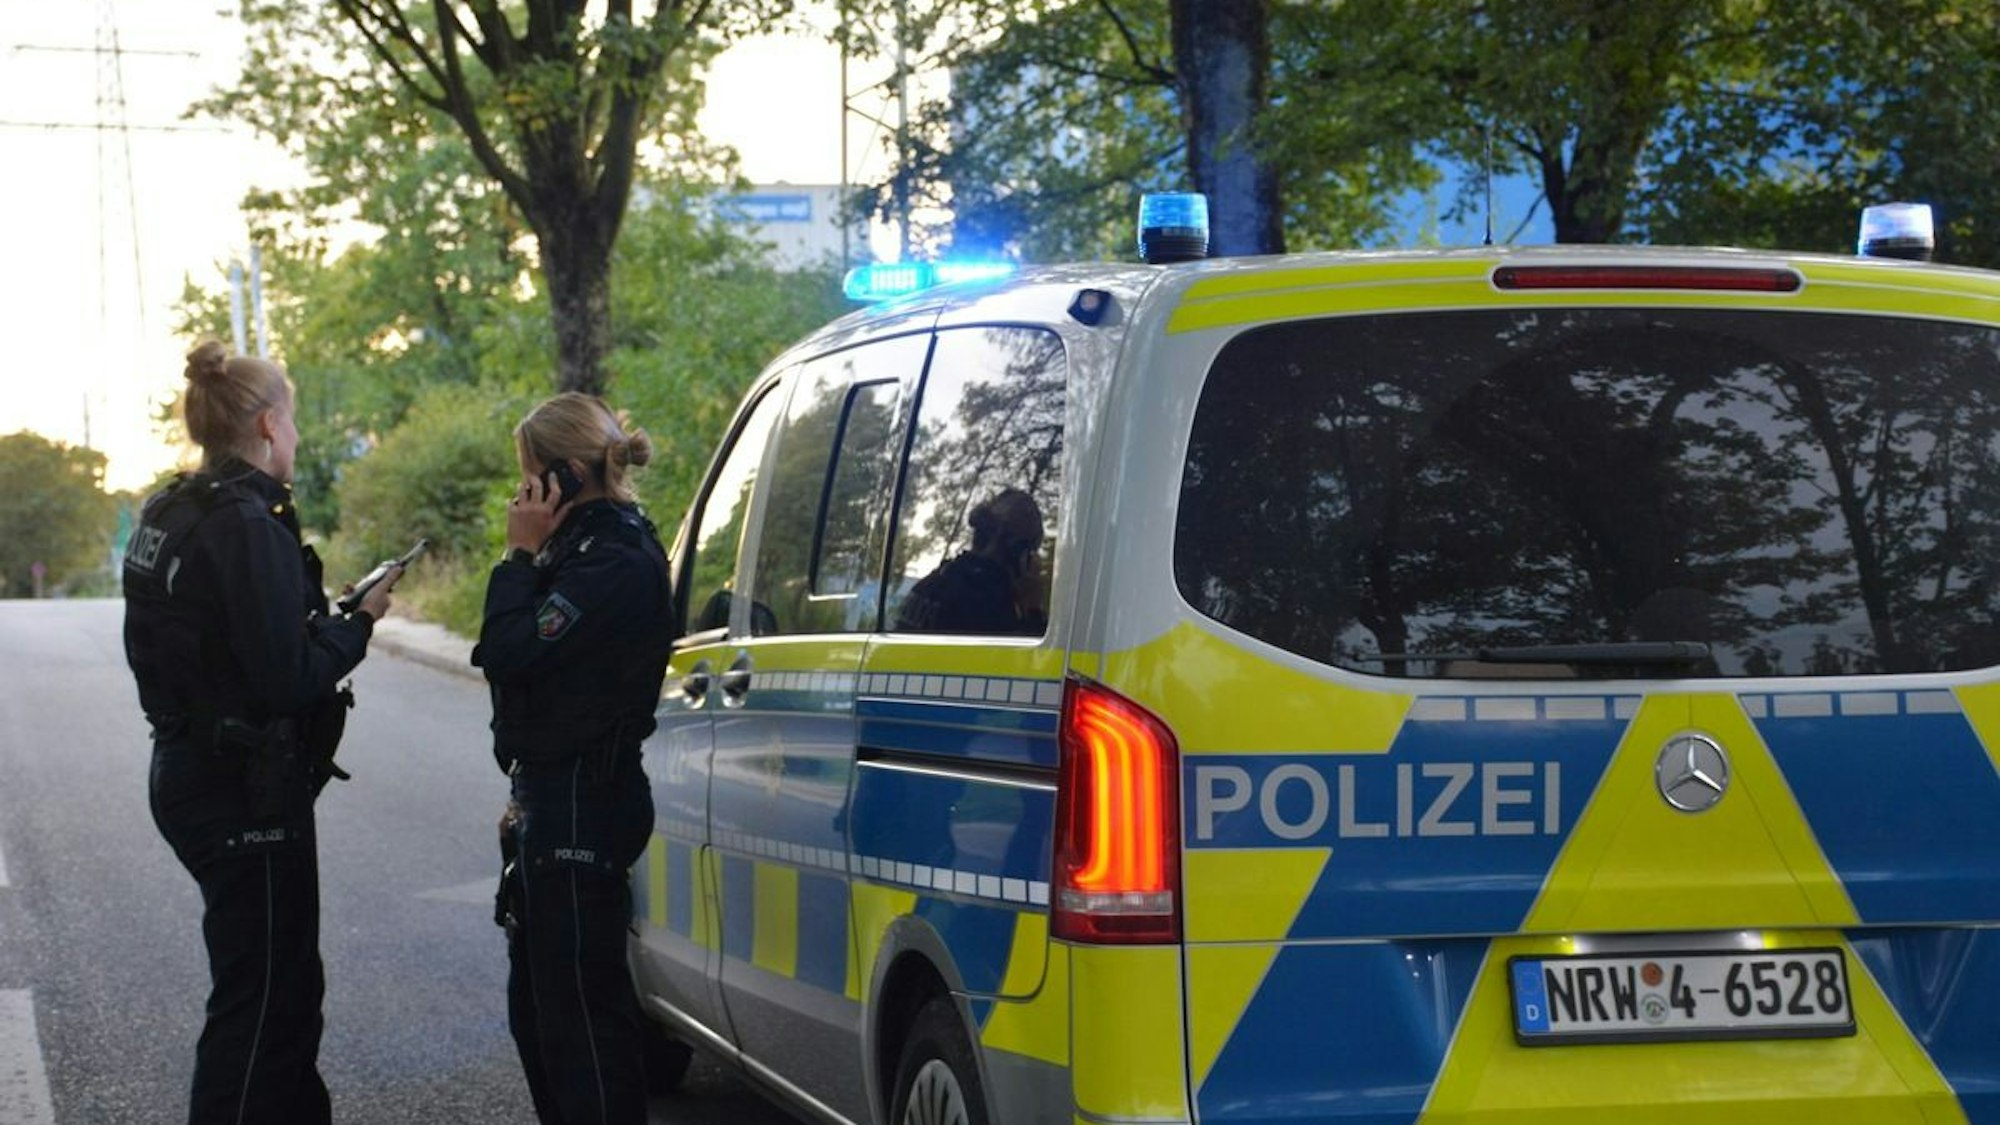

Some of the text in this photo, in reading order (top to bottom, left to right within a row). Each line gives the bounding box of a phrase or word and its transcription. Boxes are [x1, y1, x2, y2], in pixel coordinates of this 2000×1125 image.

[1195, 761, 1561, 840] POLIZEI
[242, 828, 285, 843] POLIZEI
[554, 848, 596, 863] POLIZEI
[1545, 959, 1843, 1023] NRW 4-6528
[1525, 1003, 1540, 1022] D
